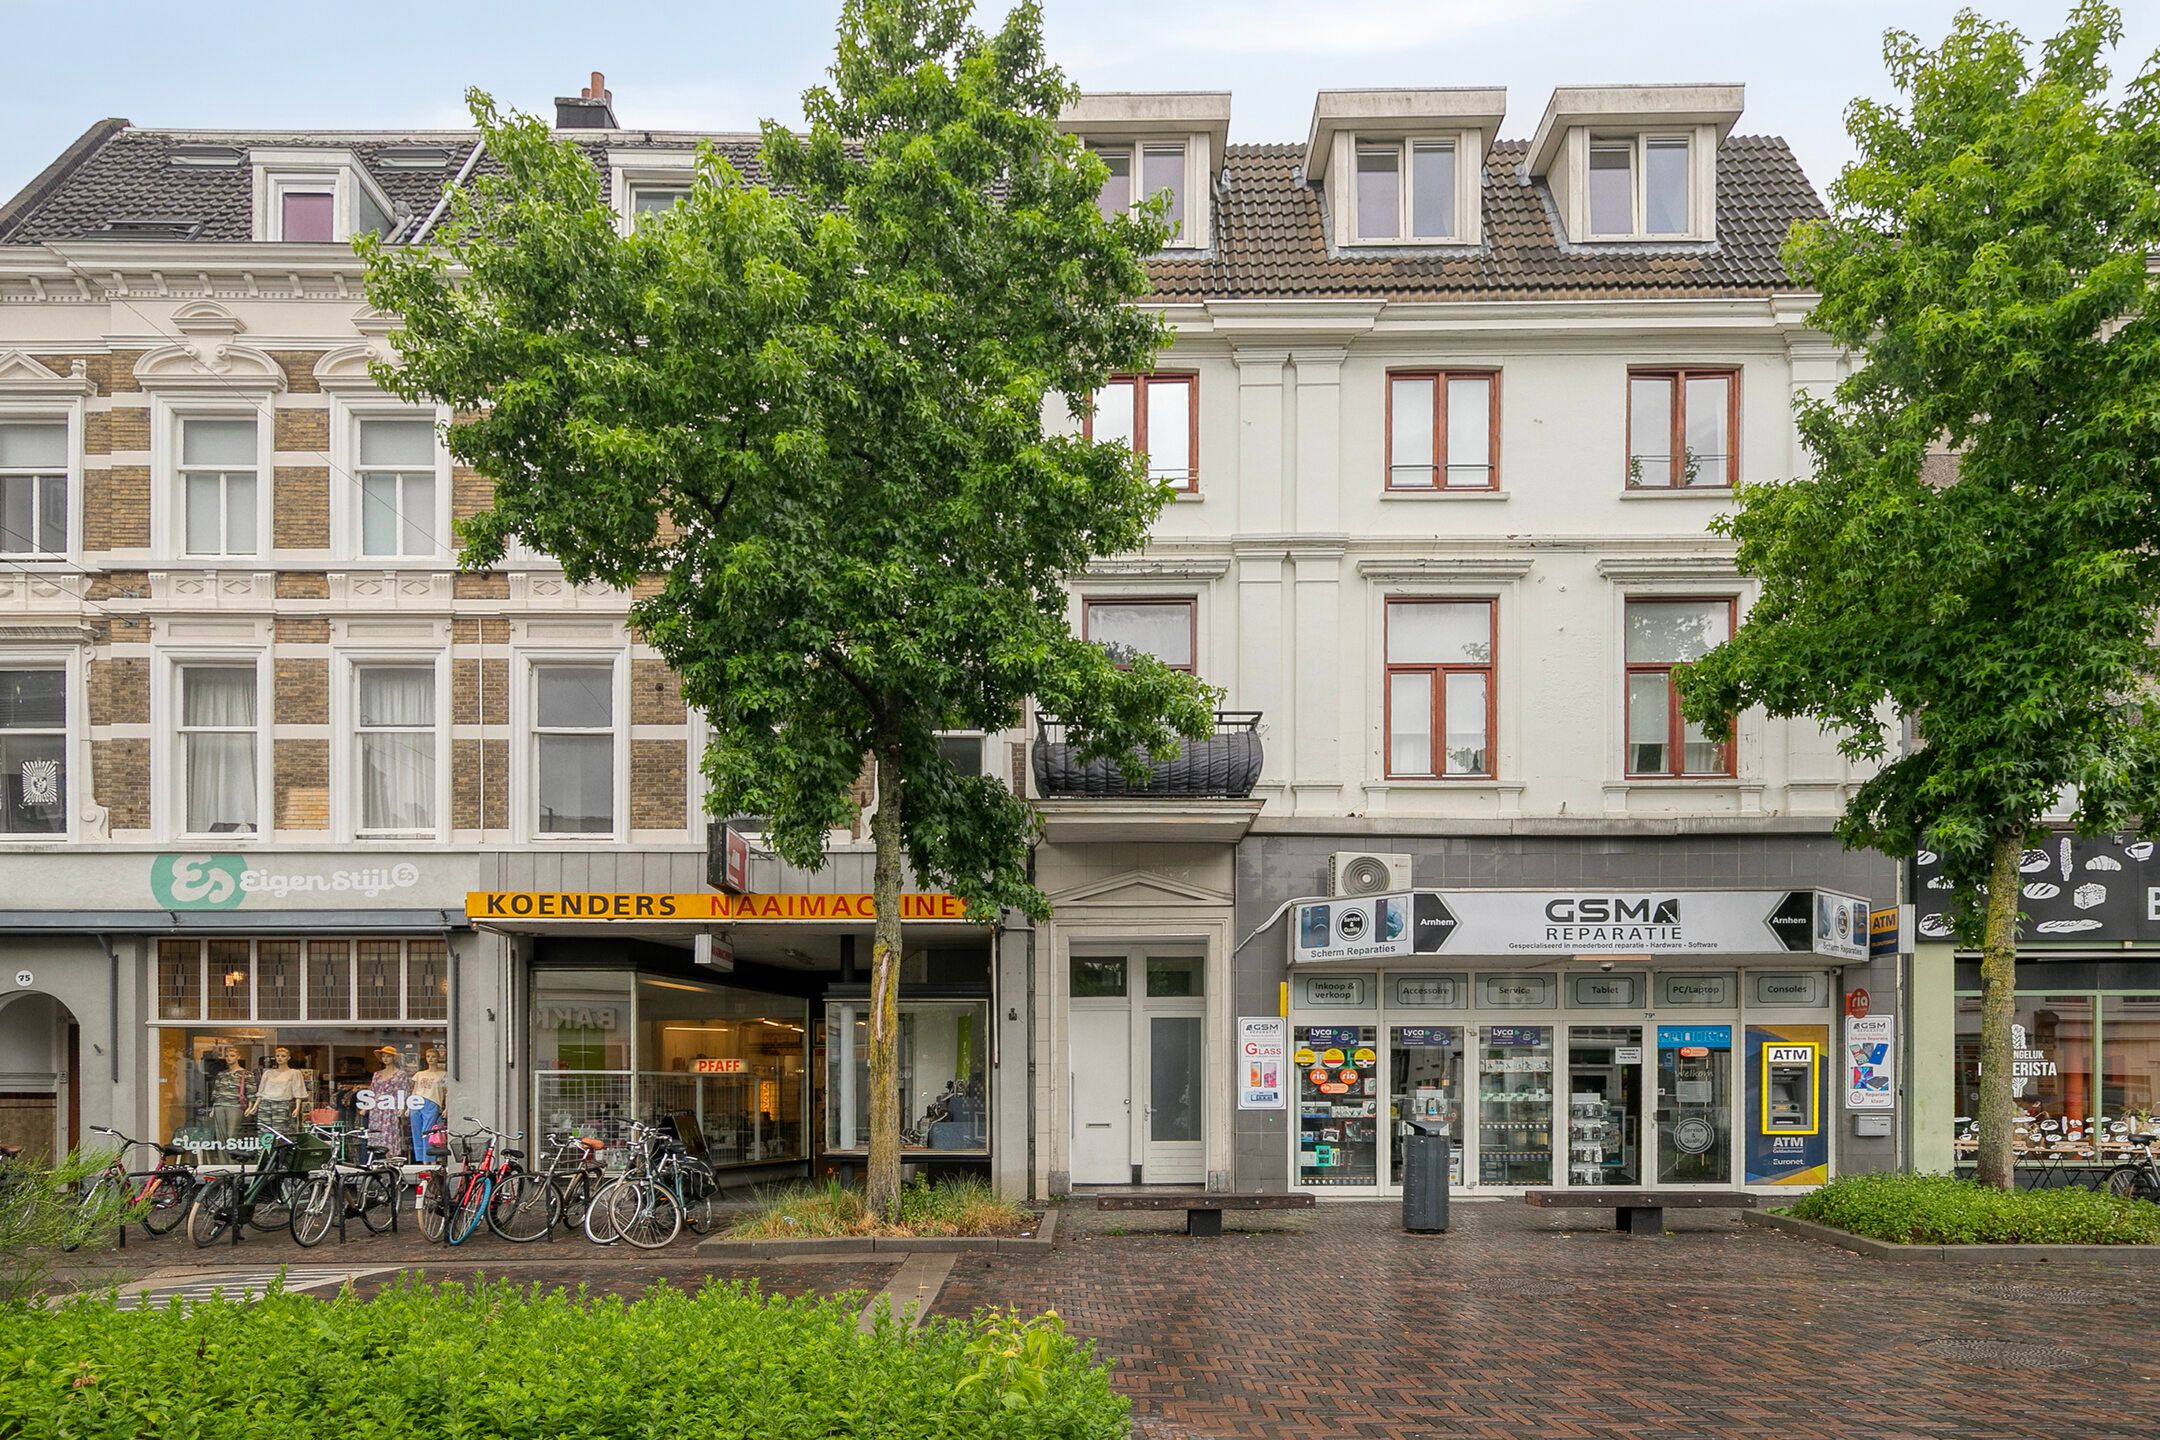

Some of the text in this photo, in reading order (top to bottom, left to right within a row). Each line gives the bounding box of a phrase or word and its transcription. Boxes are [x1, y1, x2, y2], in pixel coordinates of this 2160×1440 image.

[240, 869, 395, 898] Eigen Stijl
[486, 894, 973, 916] KOENDERS NAAIMACINE
[1544, 898, 1650, 923] GSM
[1420, 918, 1455, 926] Arnhem
[1771, 916, 1807, 924] Arnhem
[1872, 913, 1896, 930] ATM
[1546, 927, 1682, 941] REPARATIE
[1508, 942, 1563, 950] Gespecialiseerd
[1614, 942, 1645, 950] reparatie
[1311, 945, 1396, 958] Scherm Reparaties
[18, 974, 31, 982] 75
[1314, 982, 1348, 992] Inkoop
[1402, 986, 1449, 995] Accessoire
[1498, 986, 1531, 994] Service
[1591, 985, 1619, 994] Tablet
[1672, 985, 1720, 996] PC/Laptop
[1767, 985, 1807, 993] Consoles
[1314, 991, 1352, 1000] verkoop
[1852, 991, 1868, 1008] ria
[1253, 1023, 1279, 1031] GSM
[1310, 1027, 1332, 1037] Lyca
[1403, 1028, 1425, 1037] Lyca
[1492, 1028, 1514, 1037] Lyca
[1773, 1049, 1808, 1060] ATM
[2013, 1050, 2044, 1059] NGELUK
[698, 1059, 740, 1072] PFAFF
[1312, 1071, 1326, 1080] ria
[1341, 1071, 1356, 1080] ria
[1675, 1068, 1714, 1078] Welkom
[356, 1089, 425, 1110] Sale
[1773, 1137, 1804, 1147] ATM
[1773, 1158, 1804, 1166] Euronet
